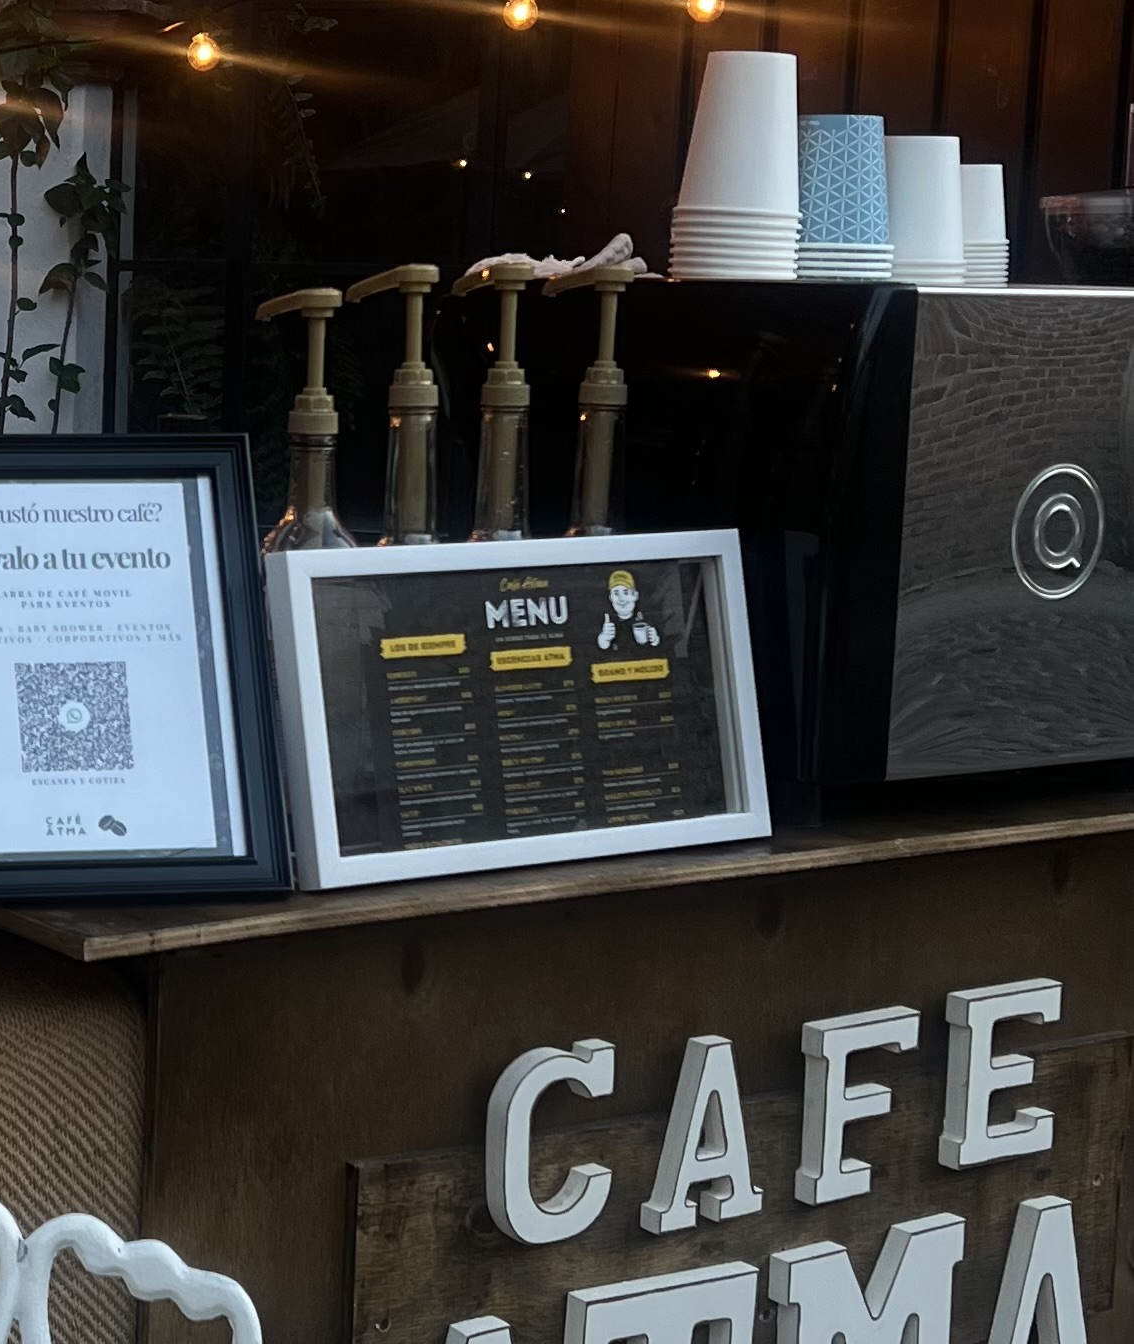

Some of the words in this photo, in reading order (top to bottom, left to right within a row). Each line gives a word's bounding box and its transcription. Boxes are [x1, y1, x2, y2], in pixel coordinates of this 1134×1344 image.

[43, 505, 115, 524] nuestro
[117, 502, 163, 523] café?
[43, 551, 59, 570] a
[61, 548, 88, 570] tu
[91, 547, 172, 570] evento
[38, 589, 53, 598] DE
[56, 600, 111, 609] EVENTOS
[484, 595, 569, 630] MENU
[484, 977, 1063, 1245] CAFE
